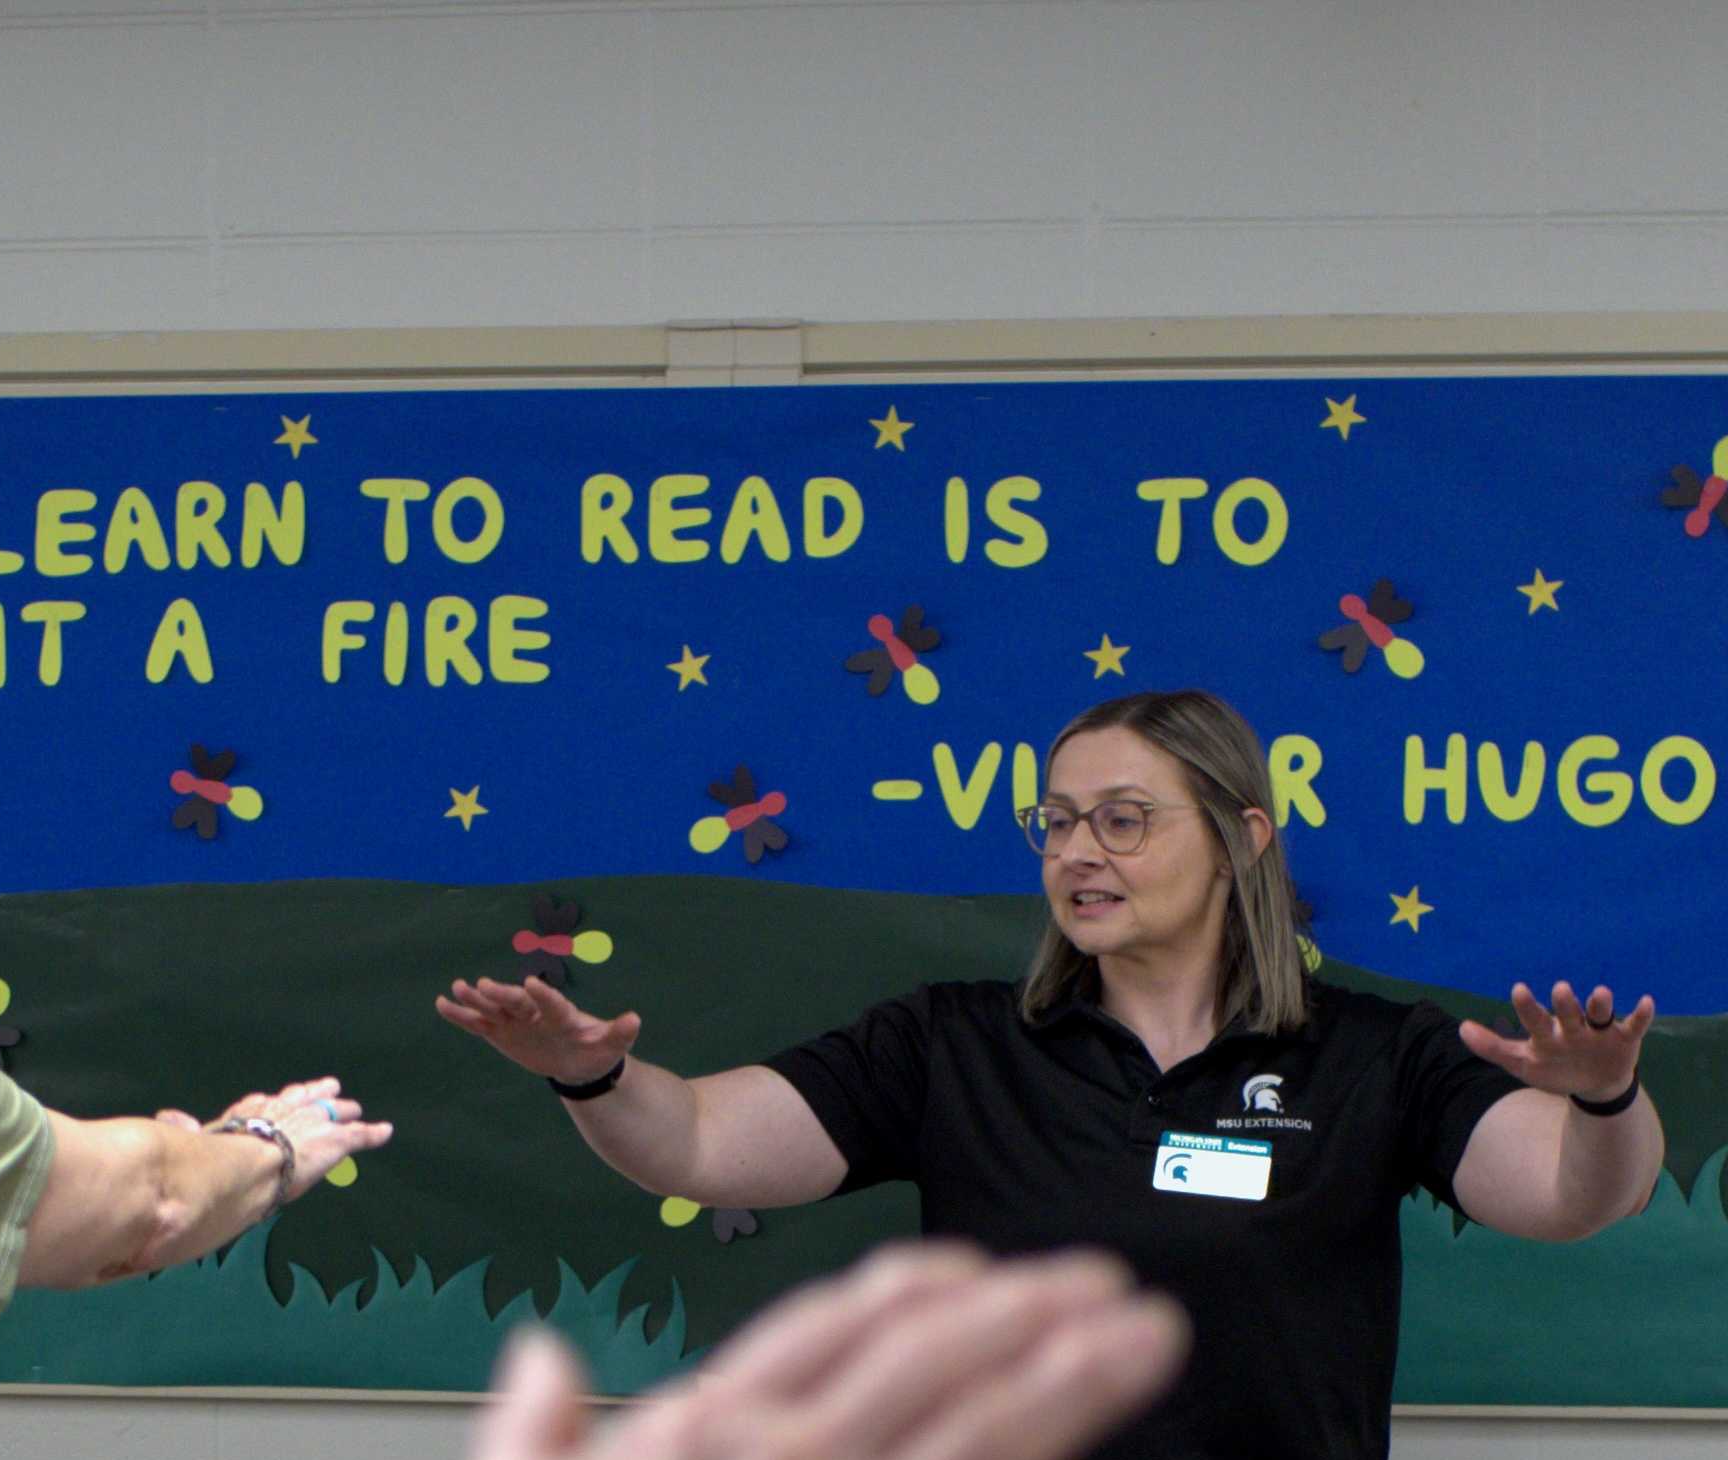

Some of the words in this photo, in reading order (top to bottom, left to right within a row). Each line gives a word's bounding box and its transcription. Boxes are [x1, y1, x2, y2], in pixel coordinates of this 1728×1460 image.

[359, 476, 505, 564] TO
[580, 473, 864, 564] READ
[943, 476, 1049, 568] IS
[1136, 476, 1289, 566] TO
[145, 598, 214, 684] A
[321, 595, 552, 687] FIRE
[872, 733, 1326, 830] -VIR
[1403, 733, 1717, 827] HUGO
[1216, 1118, 1242, 1129] MSU
[1244, 1118, 1313, 1132] EXTENSION
[1227, 1141, 1268, 1154] Extension
